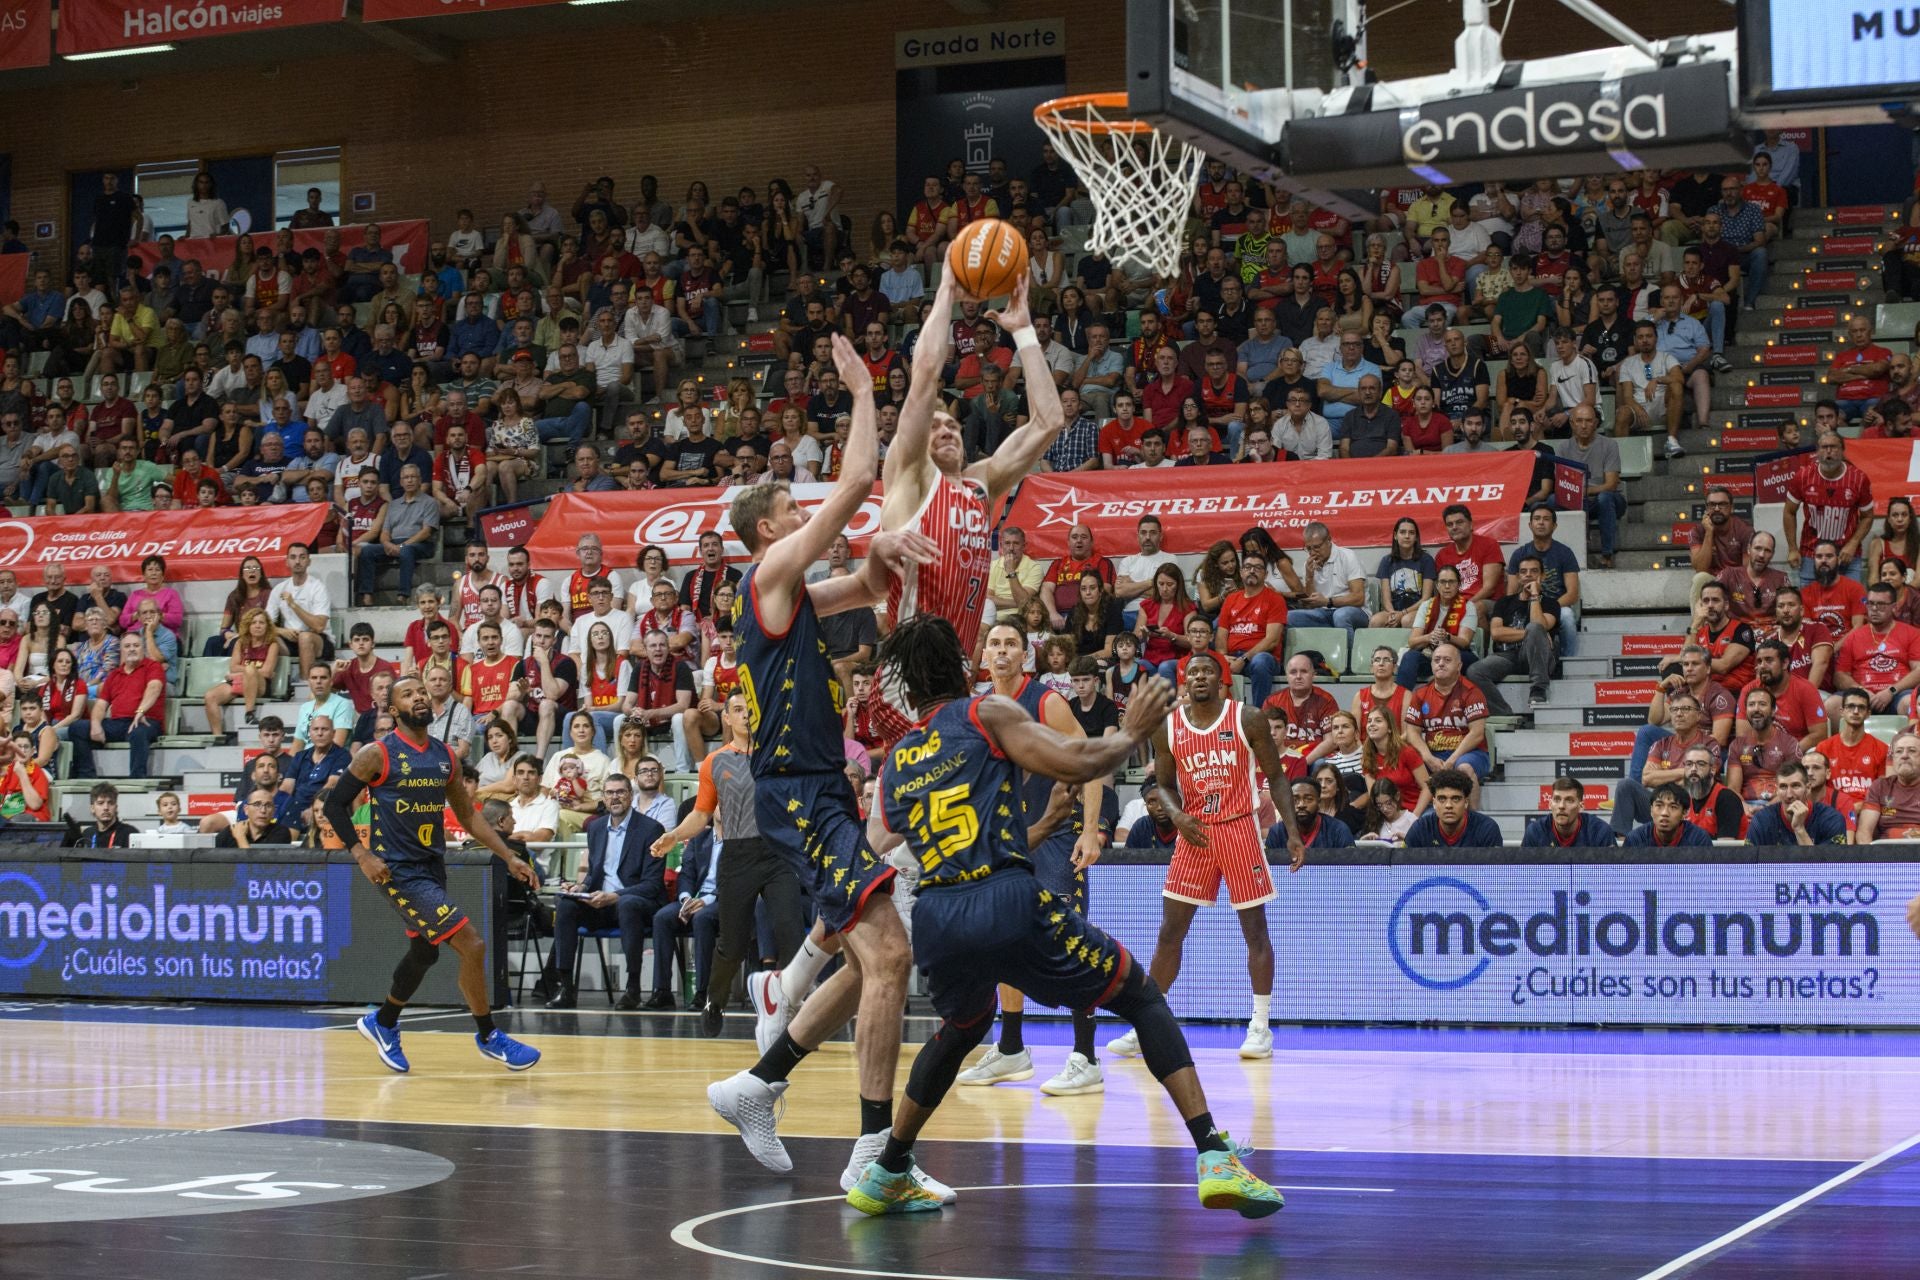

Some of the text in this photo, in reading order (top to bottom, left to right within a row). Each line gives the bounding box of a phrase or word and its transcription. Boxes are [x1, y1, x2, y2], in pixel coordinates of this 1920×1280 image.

[123, 3, 283, 38] Halcón viajes
[903, 28, 1056, 58] Grada Norte
[1402, 91, 1666, 161] endesa
[1779, 130, 1806, 140] ÓDULO
[956, 337, 976, 349] UCA
[1763, 471, 1796, 487] MÓDULO
[1776, 486, 1786, 494] 10
[1098, 483, 1505, 518] ESTRELLA DE LEVANTE
[1253, 509, 1305, 519] MURCIA
[52, 530, 127, 542] Costa Cálida
[491, 520, 527, 535] MÓDULO
[508, 532, 515, 540] 9
[37, 537, 282, 563] REGIÓN DE MURCIA
[966, 577, 980, 610] 2
[894, 729, 942, 772] PONS
[1181, 749, 1237, 773] UCAM
[1192, 768, 1230, 781] MURCIA
[1832, 776, 1873, 790] UCAM
[411, 801, 445, 813] Andorr
[1203, 793, 1221, 814] 31
[248, 880, 323, 900] BANCO
[1775, 882, 1879, 906] BANCO
[0, 883, 323, 943] mediolanum
[1410, 889, 1880, 957] mediolanum
[61, 948, 324, 981] ¿Cuáles son tus metas?
[1511, 966, 1879, 1005] ¿Cuáles son tus metas?
